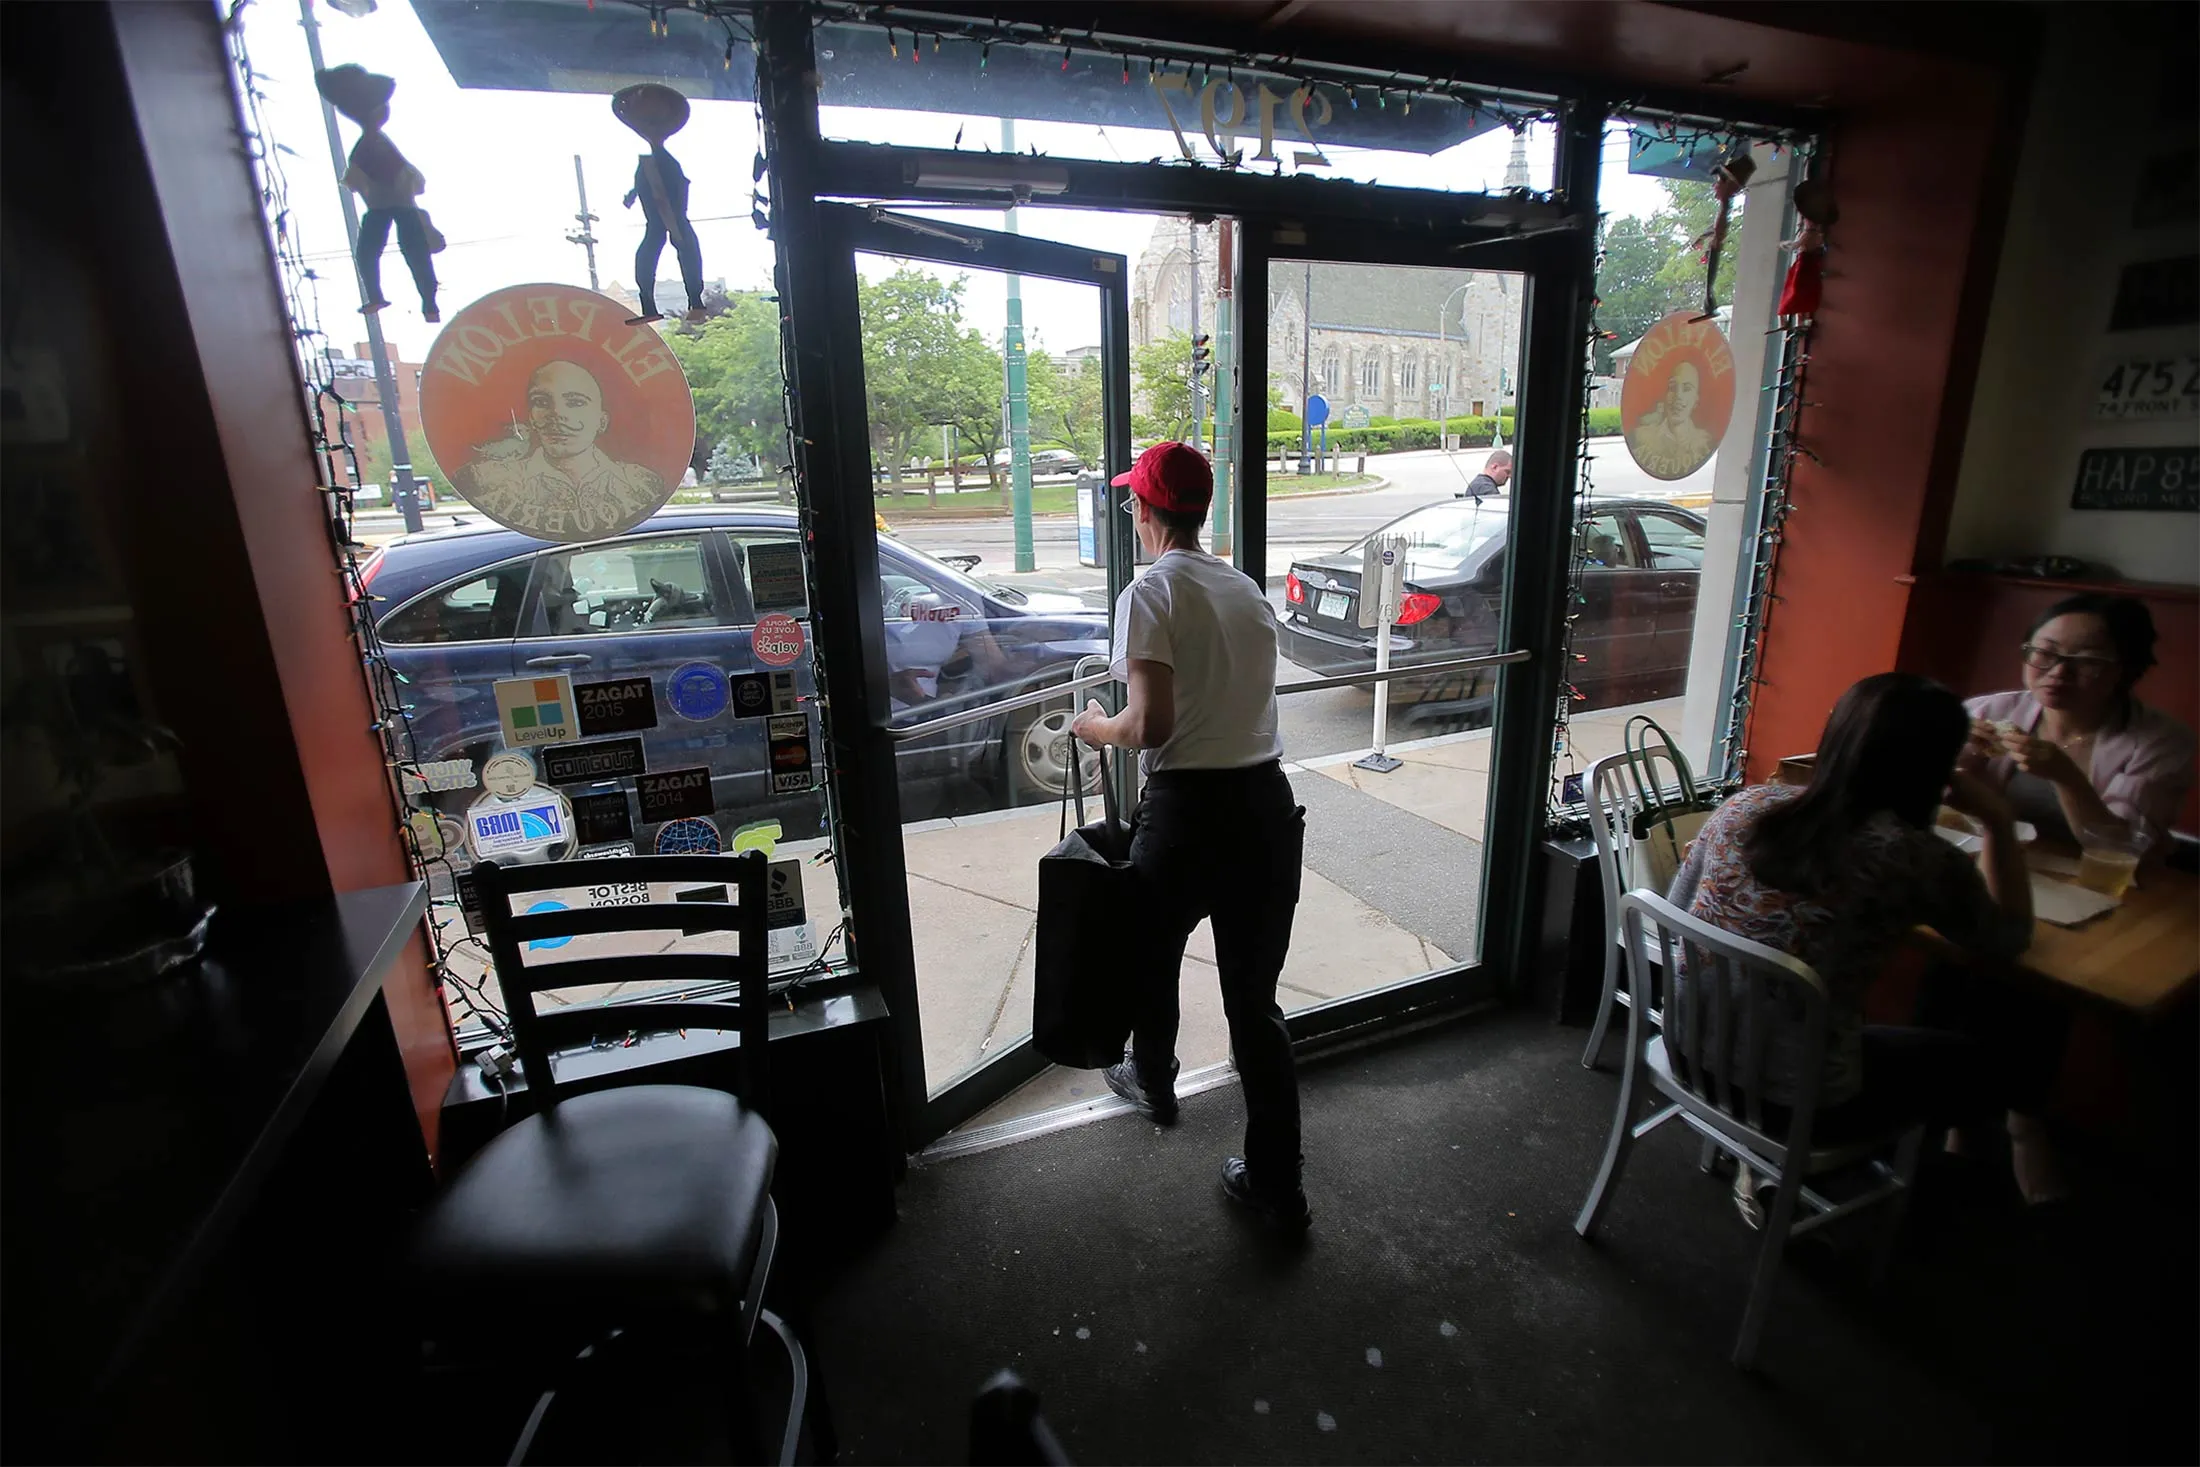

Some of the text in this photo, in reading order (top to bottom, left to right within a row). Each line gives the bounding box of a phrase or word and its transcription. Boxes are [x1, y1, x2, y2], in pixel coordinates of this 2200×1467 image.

[2102, 358, 2175, 398] 475
[2081, 453, 2156, 491] HAP
[581, 684, 646, 704] ZAGAT
[583, 702, 625, 720] 2015
[514, 727, 567, 743] LevelUp
[643, 772, 705, 794] ZAGAT
[778, 774, 810, 787] VISA
[645, 790, 684, 809] 2014
